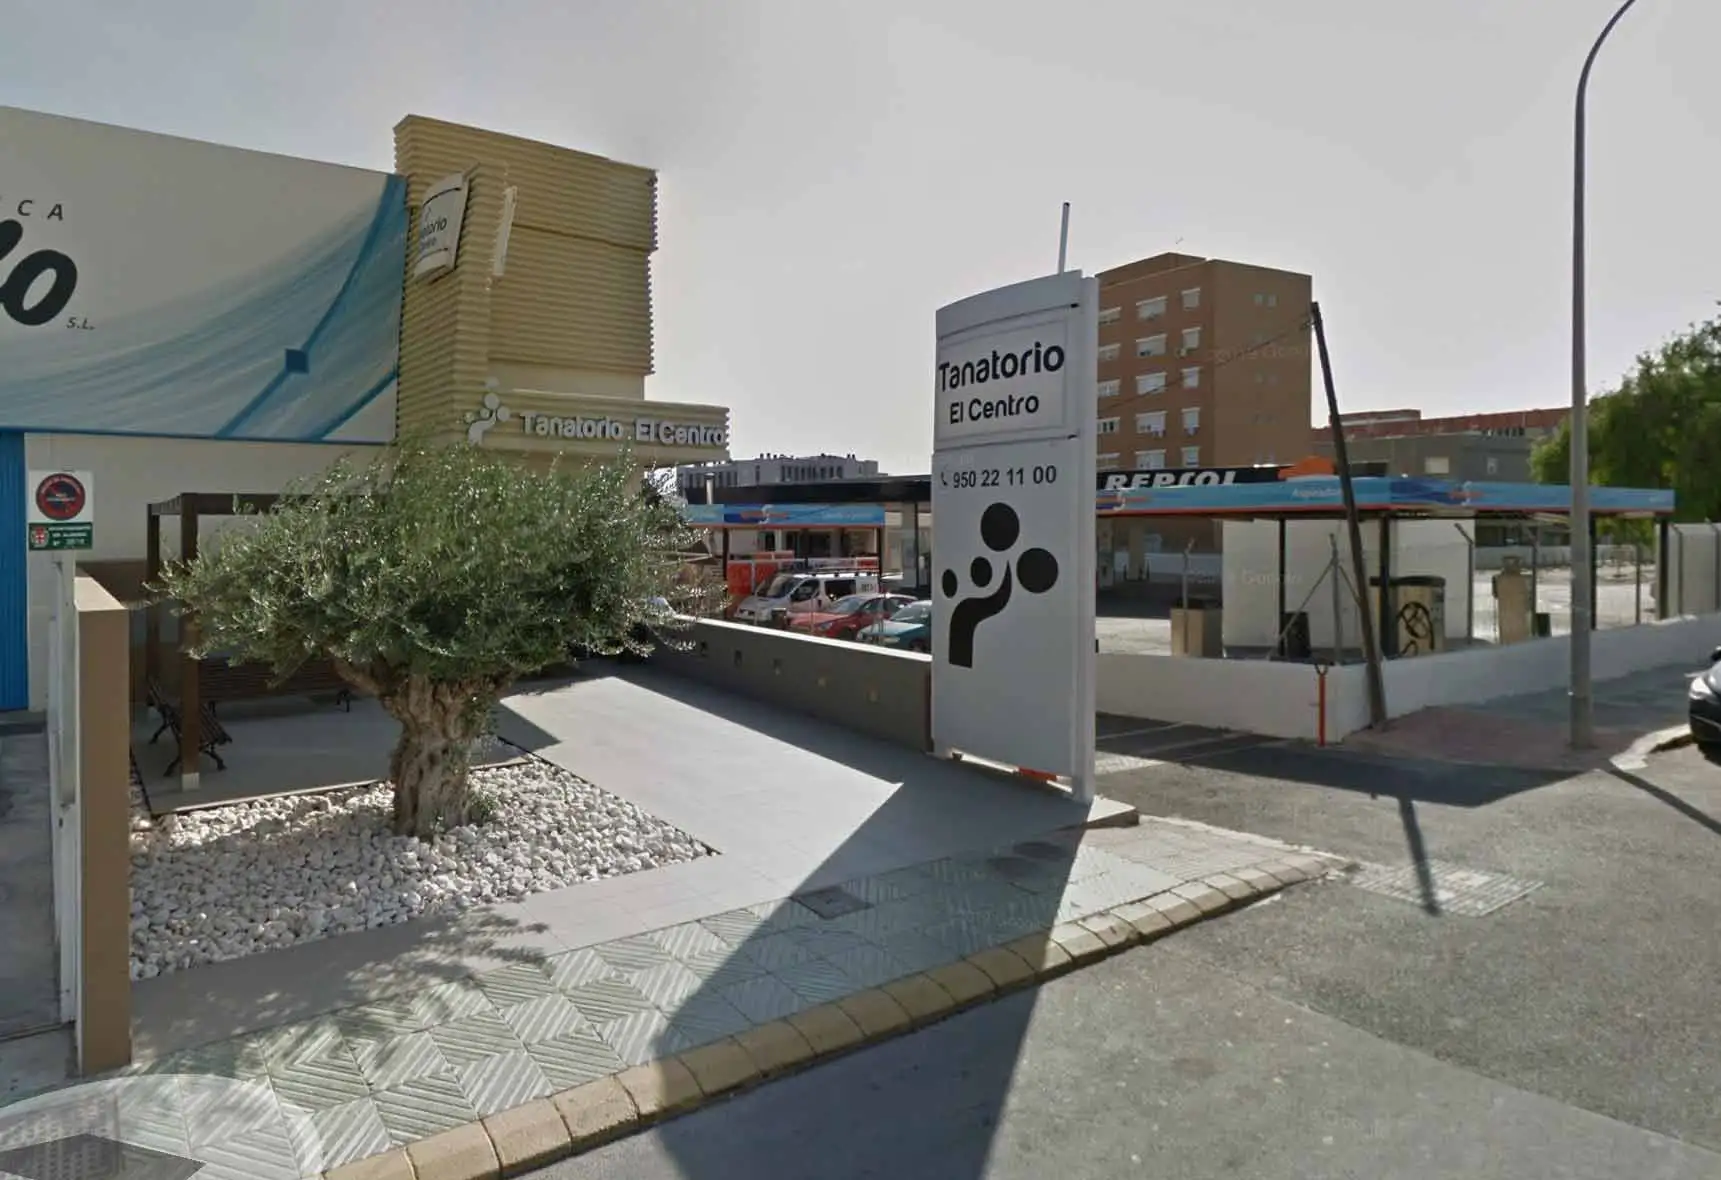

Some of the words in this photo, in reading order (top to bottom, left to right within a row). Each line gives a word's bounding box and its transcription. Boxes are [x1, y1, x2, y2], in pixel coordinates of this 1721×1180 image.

[66, 316, 95, 331] S.L.
[939, 341, 1065, 392] Tanatorio
[950, 401, 963, 424] El
[968, 394, 1040, 421] Centro
[520, 411, 625, 440] Tanatorio
[635, 417, 656, 442] El
[658, 421, 725, 446] Centro
[952, 470, 977, 489] 950
[980, 468, 1001, 487] 22
[1006, 467, 1025, 486] 11
[1032, 464, 1058, 485] 00
